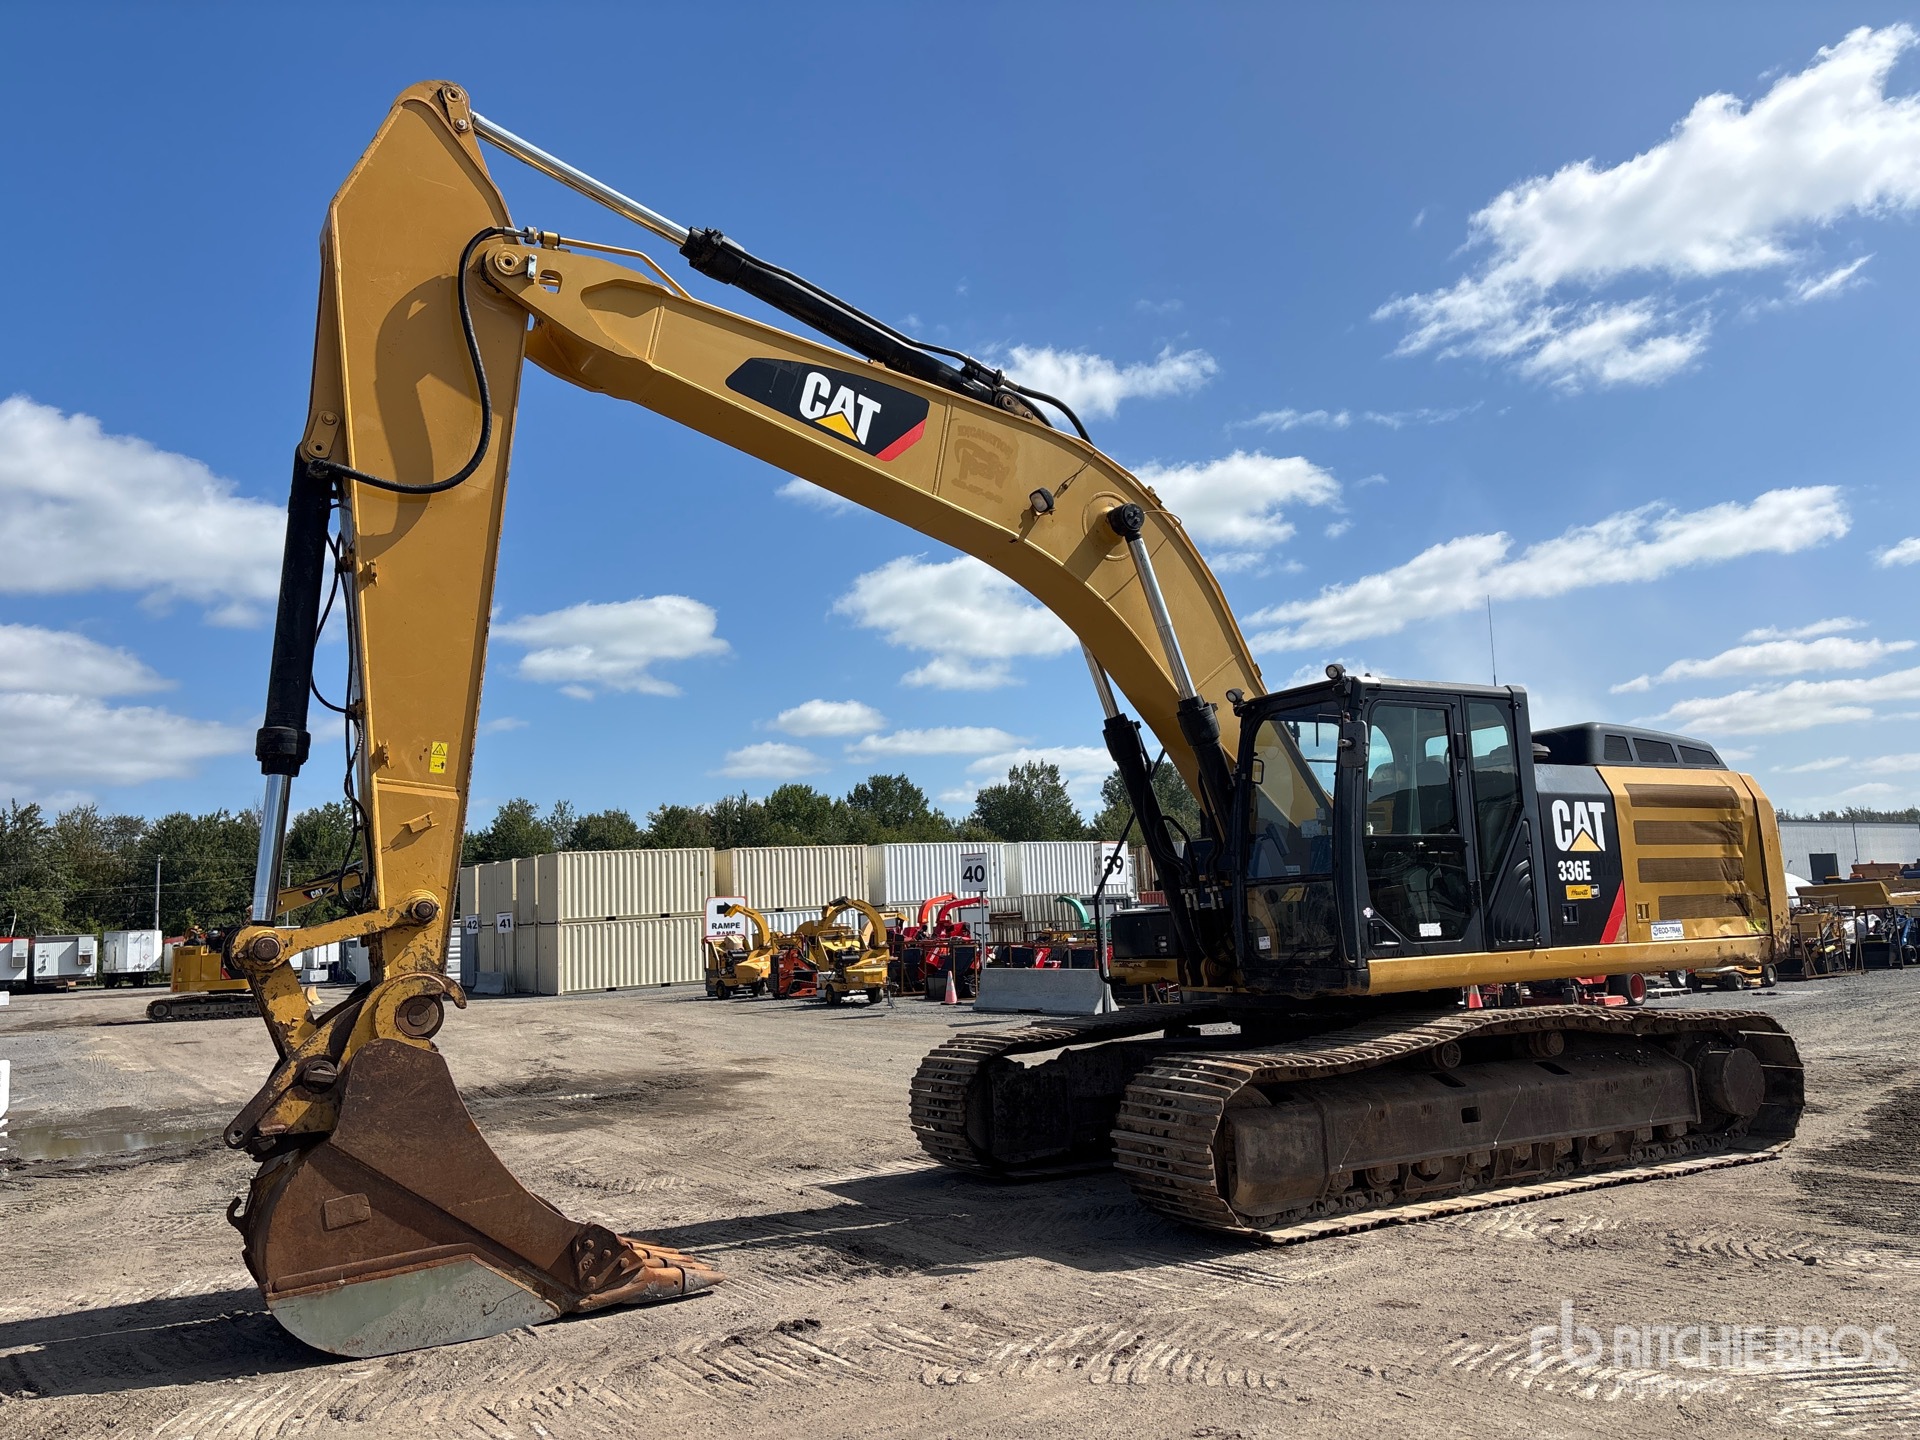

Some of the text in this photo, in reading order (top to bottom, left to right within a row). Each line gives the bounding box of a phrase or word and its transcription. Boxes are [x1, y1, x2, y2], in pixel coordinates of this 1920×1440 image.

[800, 372, 882, 445] CAT
[1551, 800, 1606, 852] CAT
[1104, 855, 1124, 875] 39
[1557, 860, 1592, 881] 336E
[962, 865, 985, 883] 40
[310, 888, 323, 899] CAT
[467, 920, 478, 930] 42
[499, 919, 511, 929] 41
[711, 922, 741, 930] RAMPE
[1658, 926, 1682, 935] ECO-TRAK
